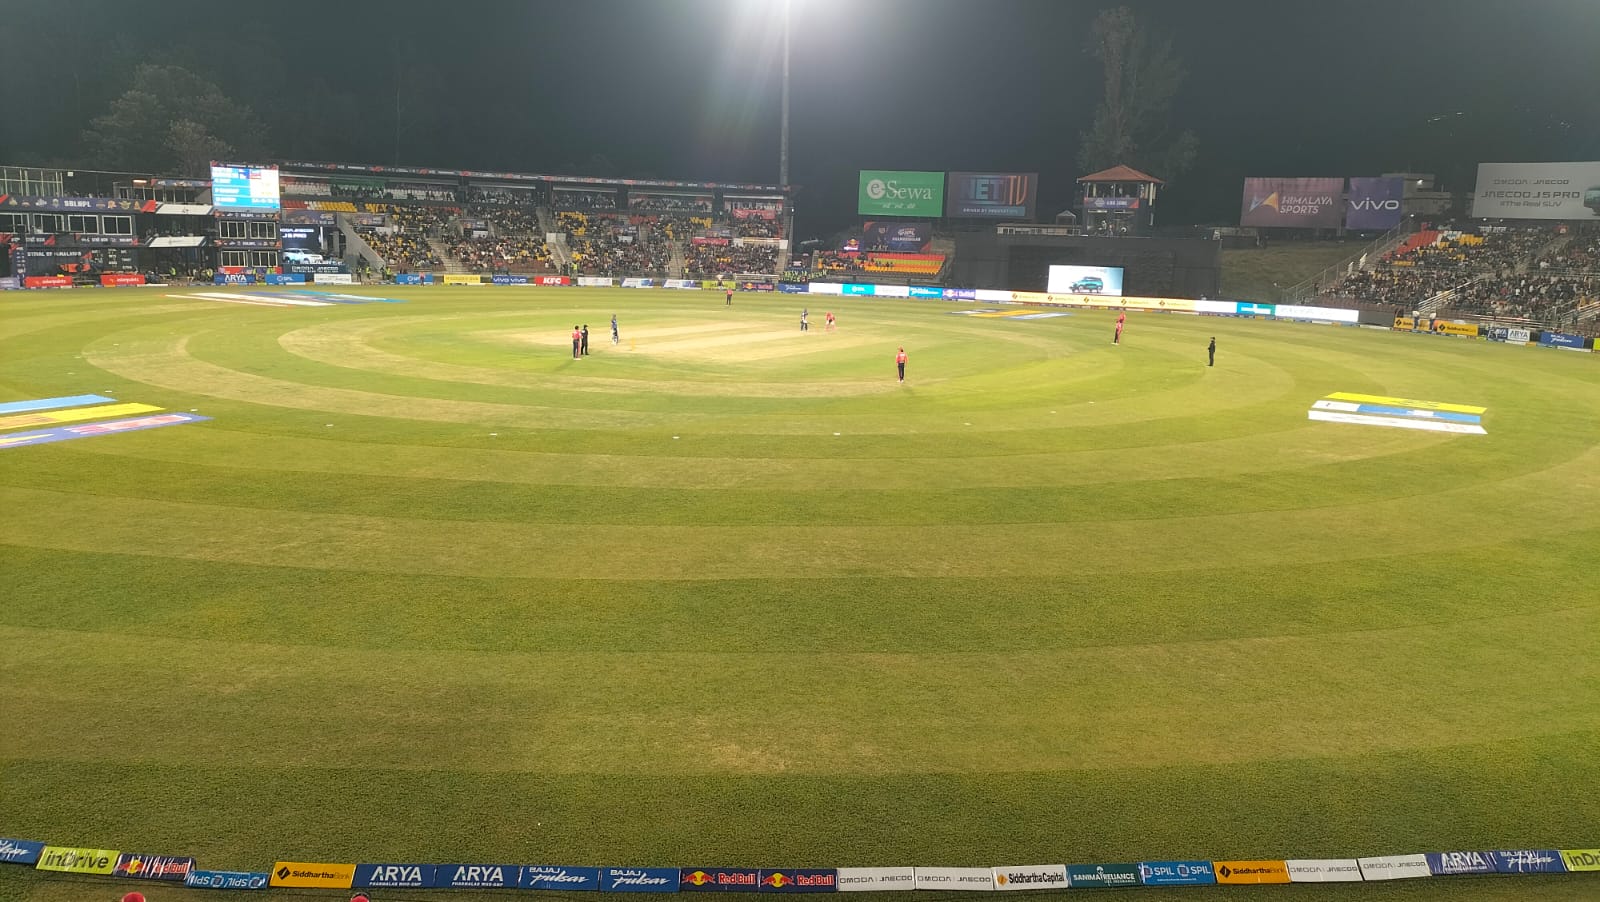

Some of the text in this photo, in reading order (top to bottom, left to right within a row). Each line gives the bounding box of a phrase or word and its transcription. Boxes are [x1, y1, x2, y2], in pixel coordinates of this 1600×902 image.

[1281, 196, 1334, 206] HIMALAYA
[1350, 197, 1399, 211] vivo
[1280, 206, 1320, 214] SPORTS
[225, 274, 246, 282] ARYA
[45, 851, 109, 869] inDrive
[1396, 860, 1426, 868] JAECOO
[1442, 851, 1486, 868] ARYA
[172, 863, 189, 874] Bull
[369, 865, 422, 881] ARYA
[453, 865, 504, 882] ARYA
[1154, 865, 1211, 877] SPIL SPIL
[1326, 865, 1358, 873] JAECOO
[718, 873, 756, 885] Red Bull
[797, 874, 835, 887] Red Bull
[1008, 872, 1065, 886] Siddhartha Capital
[1073, 873, 1101, 881] SANIMA
